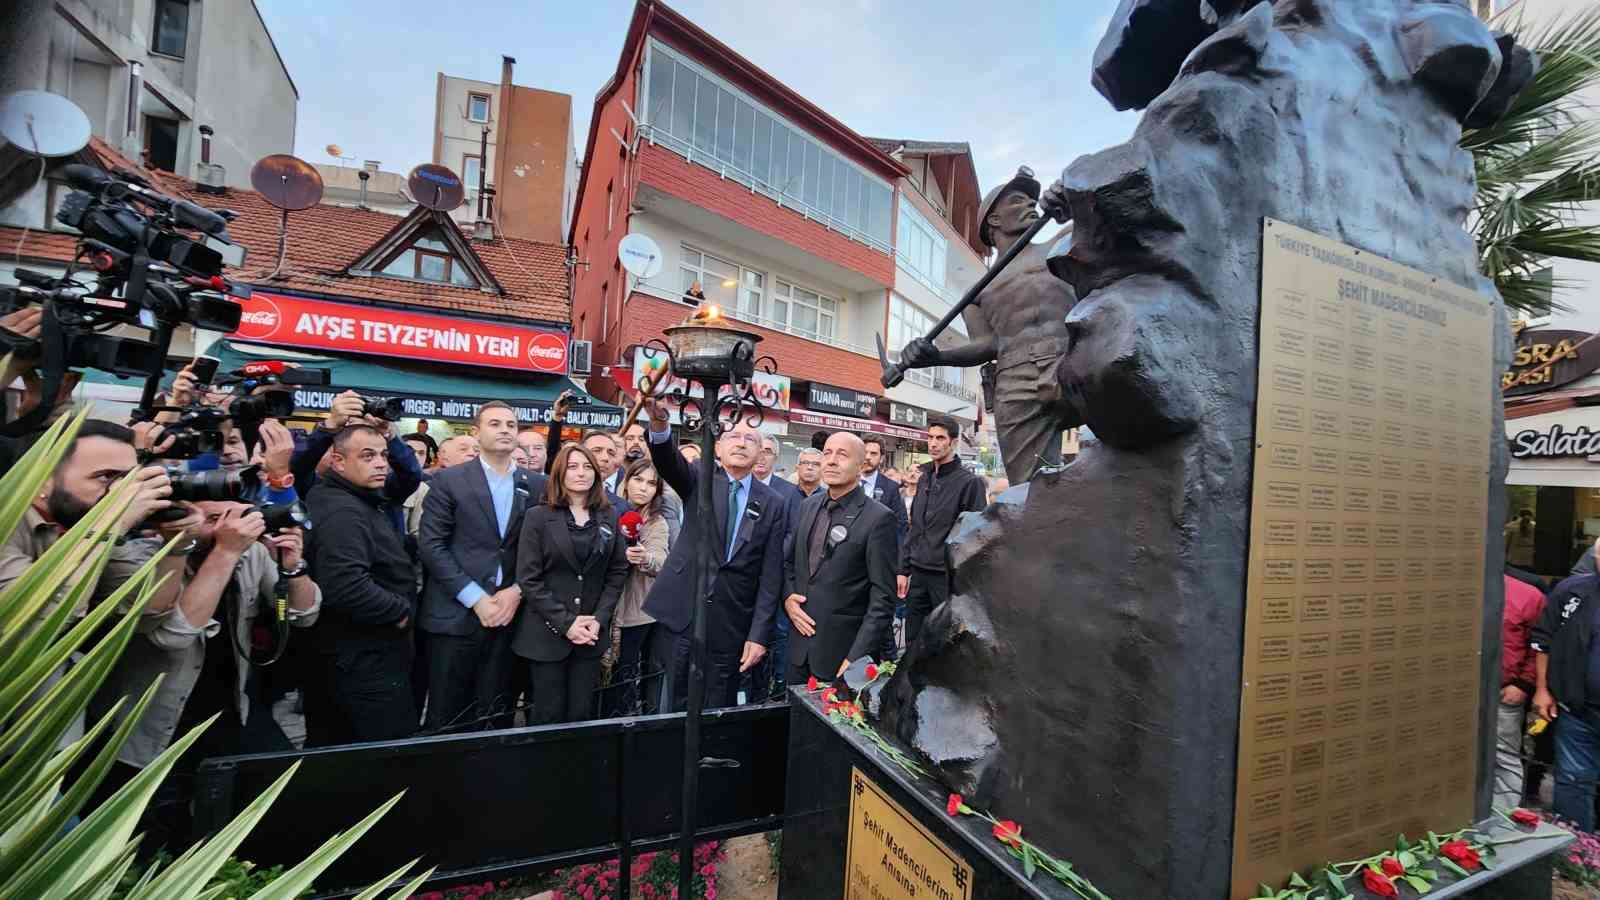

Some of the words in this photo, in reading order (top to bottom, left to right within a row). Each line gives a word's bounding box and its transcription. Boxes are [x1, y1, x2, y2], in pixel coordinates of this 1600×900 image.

[295, 312, 357, 341] AYŞE
[360, 319, 470, 353] TEYZE'NİN
[473, 333, 520, 358] YERİ
[1513, 338, 1577, 367] SRA
[294, 390, 335, 409] SUCUK
[441, 399, 472, 418] MİDYE
[566, 411, 589, 425] BALIK
[811, 389, 840, 408] TUANA
[863, 811, 885, 842] Şehit
